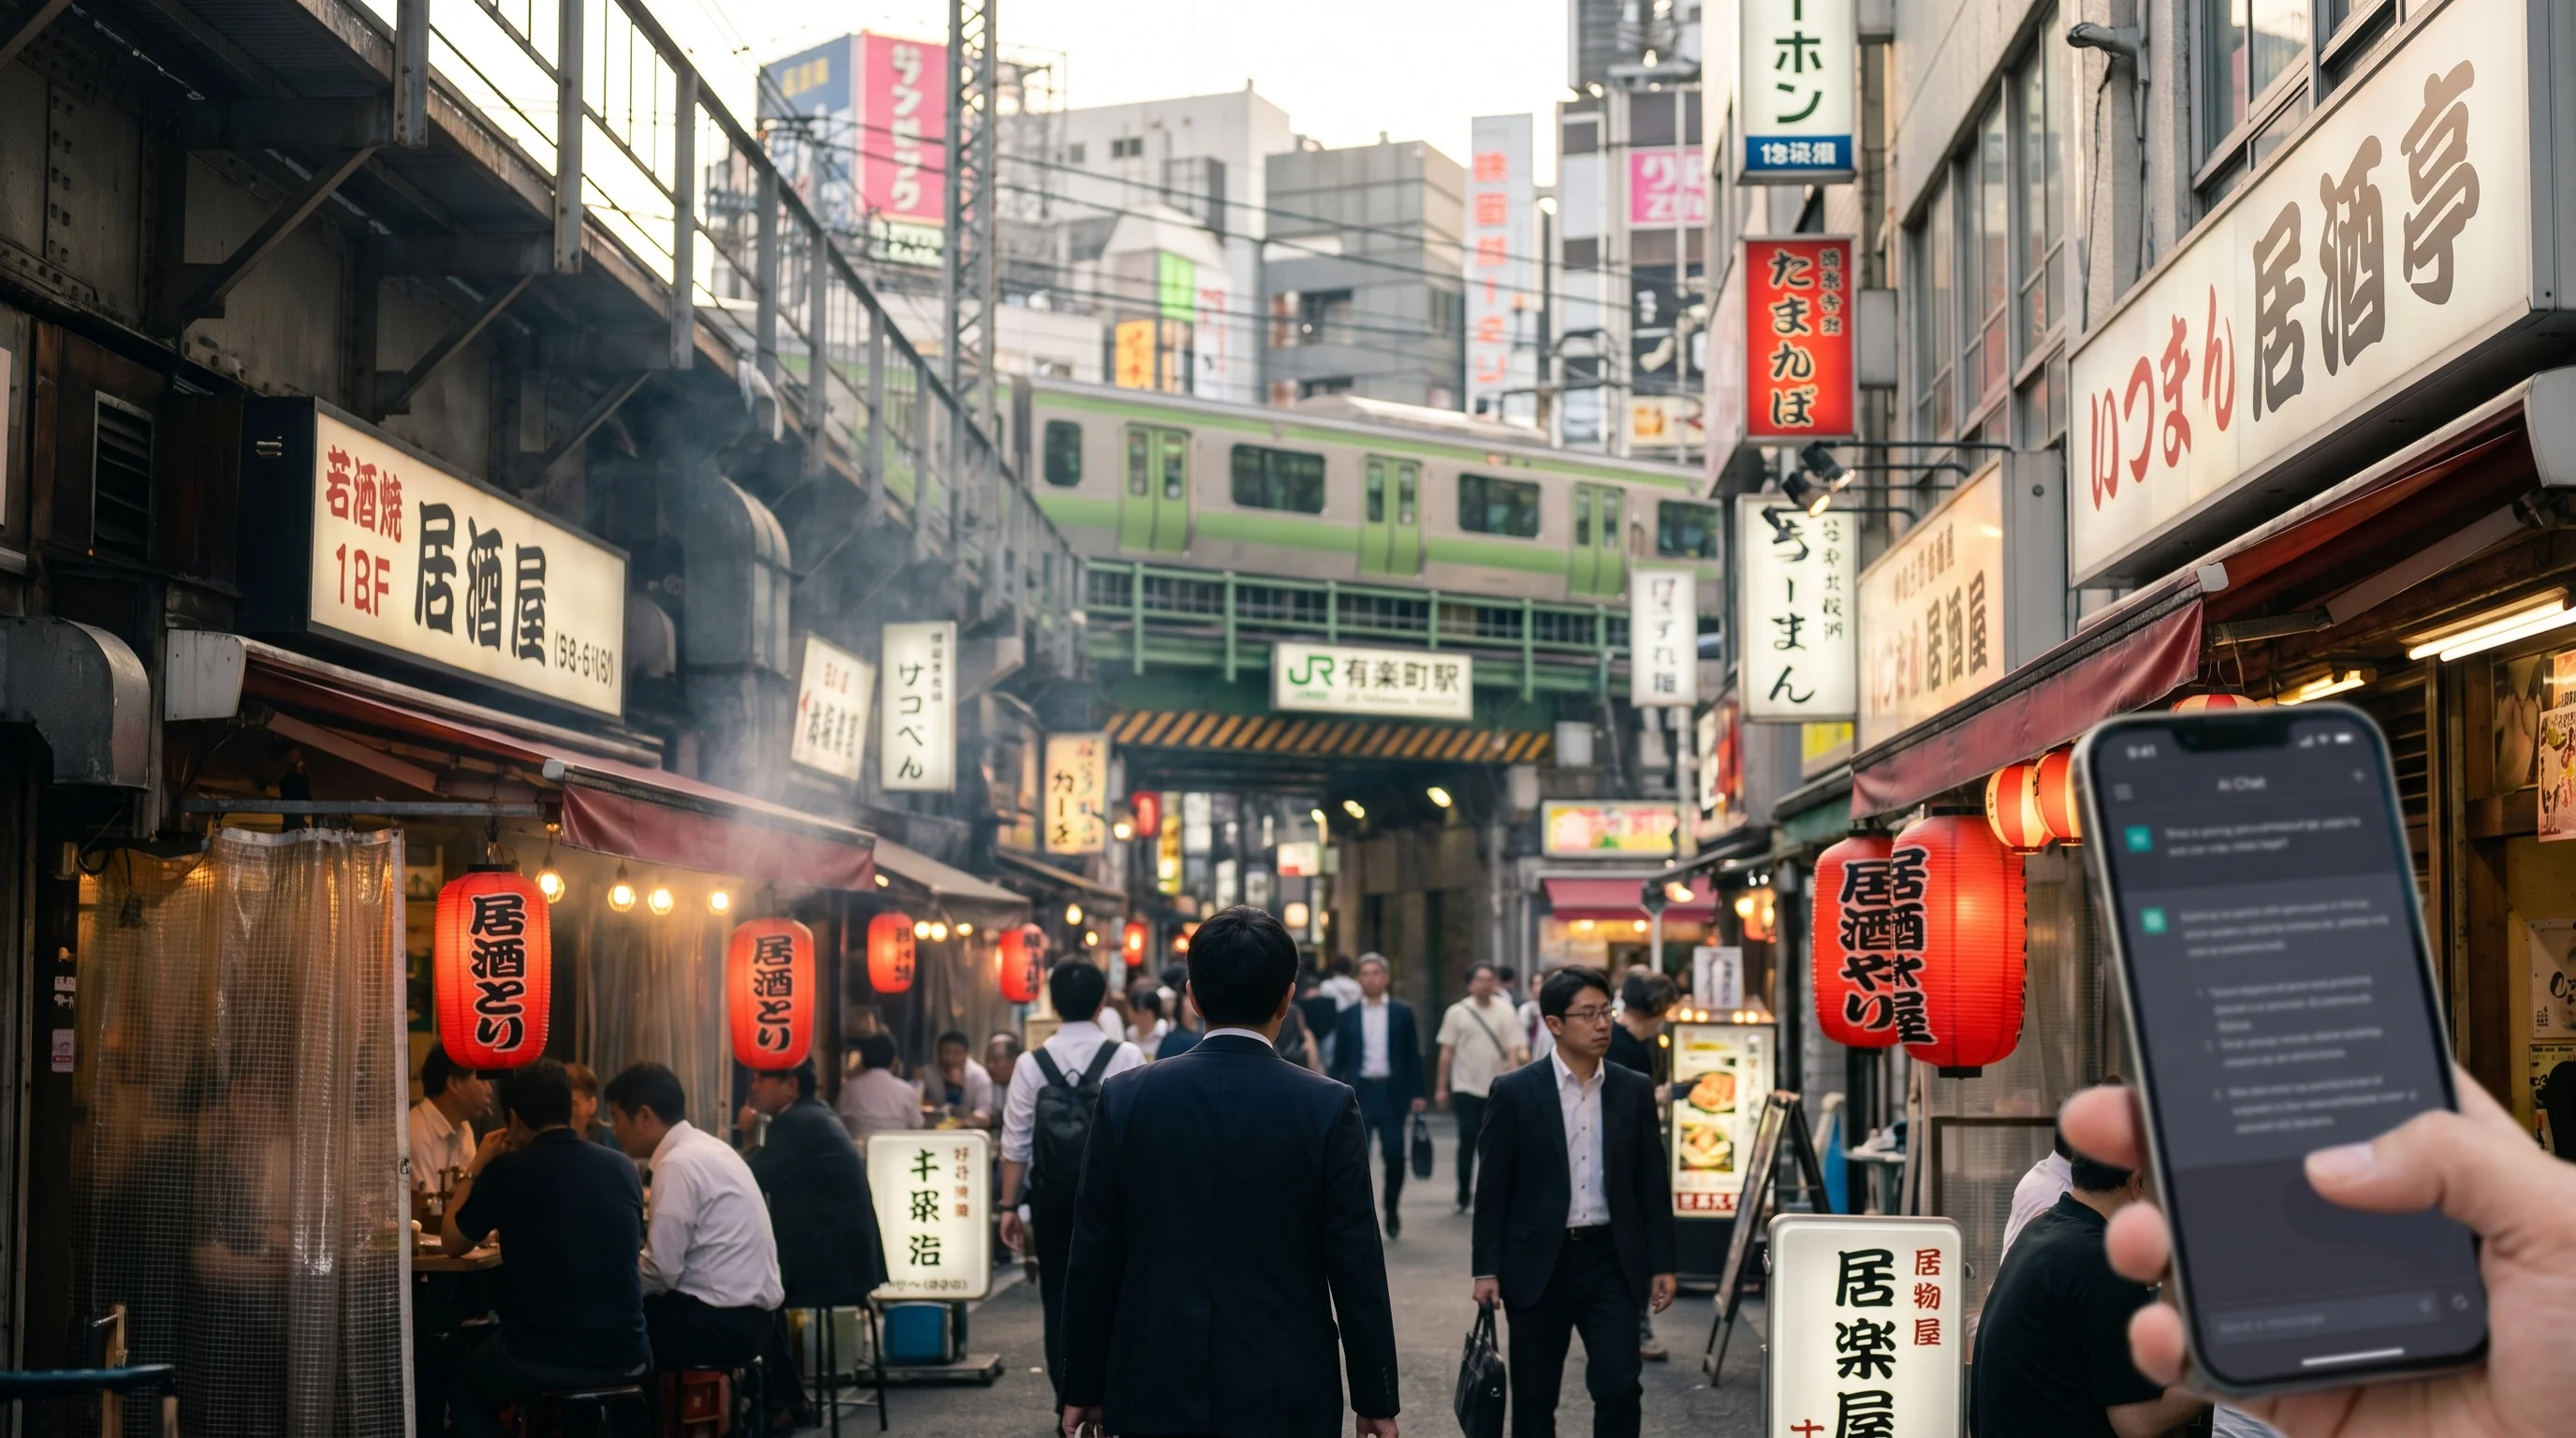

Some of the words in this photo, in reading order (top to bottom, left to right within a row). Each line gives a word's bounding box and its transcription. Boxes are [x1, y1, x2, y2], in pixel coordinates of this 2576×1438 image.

[326, 444, 403, 543] 若酒焼
[335, 542, 391, 619] 1BF
[414, 500, 549, 667] 居酒屋
[1288, 654, 1335, 686] JR
[1343, 657, 1460, 694] 有楽町駅
[2127, 744, 2157, 759] 9:41
[1835, 1248, 1896, 1438] 居楽屋
[1913, 1248, 1941, 1346] 居物屋
